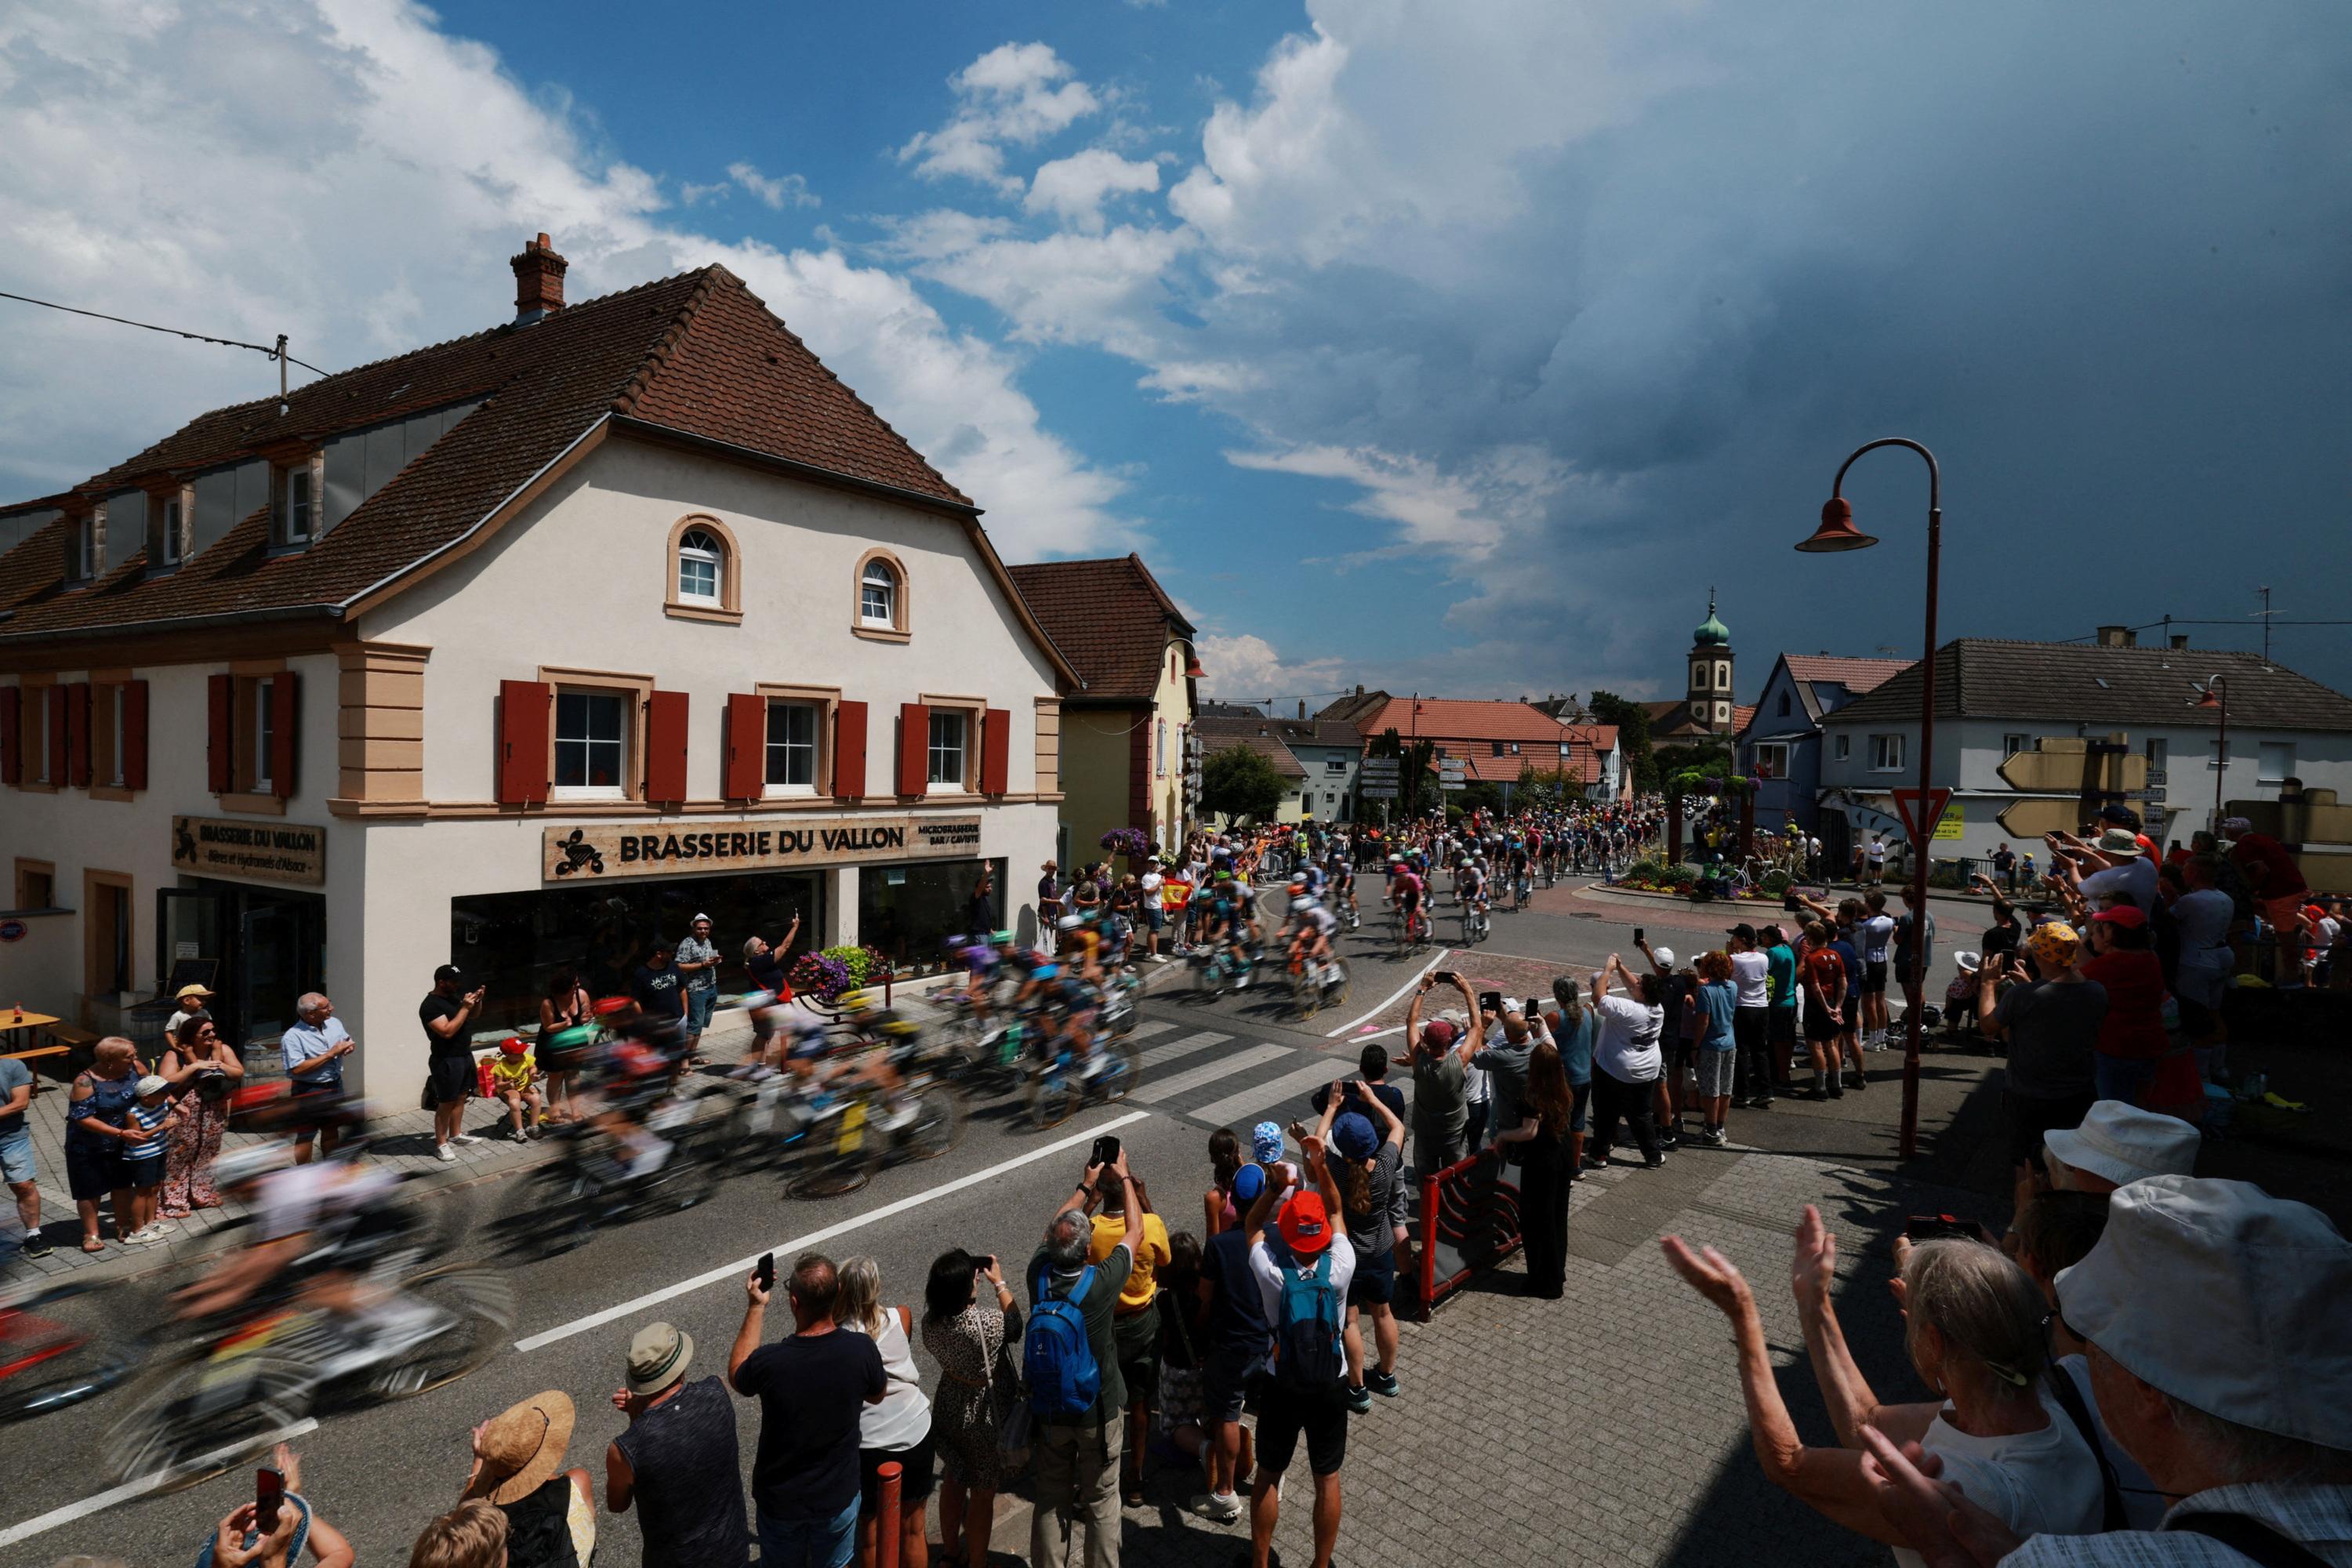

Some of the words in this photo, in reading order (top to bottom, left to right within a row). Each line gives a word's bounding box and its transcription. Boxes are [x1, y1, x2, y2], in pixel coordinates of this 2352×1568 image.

[918, 824, 979, 835] MICROBRASSERIE
[200, 825, 252, 846] BRASSERIE
[254, 829, 270, 848] DU
[273, 831, 315, 851] VALLON
[620, 831, 771, 862] BRASSERIE
[779, 830, 813, 854] DU
[821, 827, 904, 851] VALLON
[930, 836, 945, 845] BAR
[950, 835, 979, 844] CAVISTE
[229, 853, 237, 865] et
[238, 853, 274, 869] Hydromels
